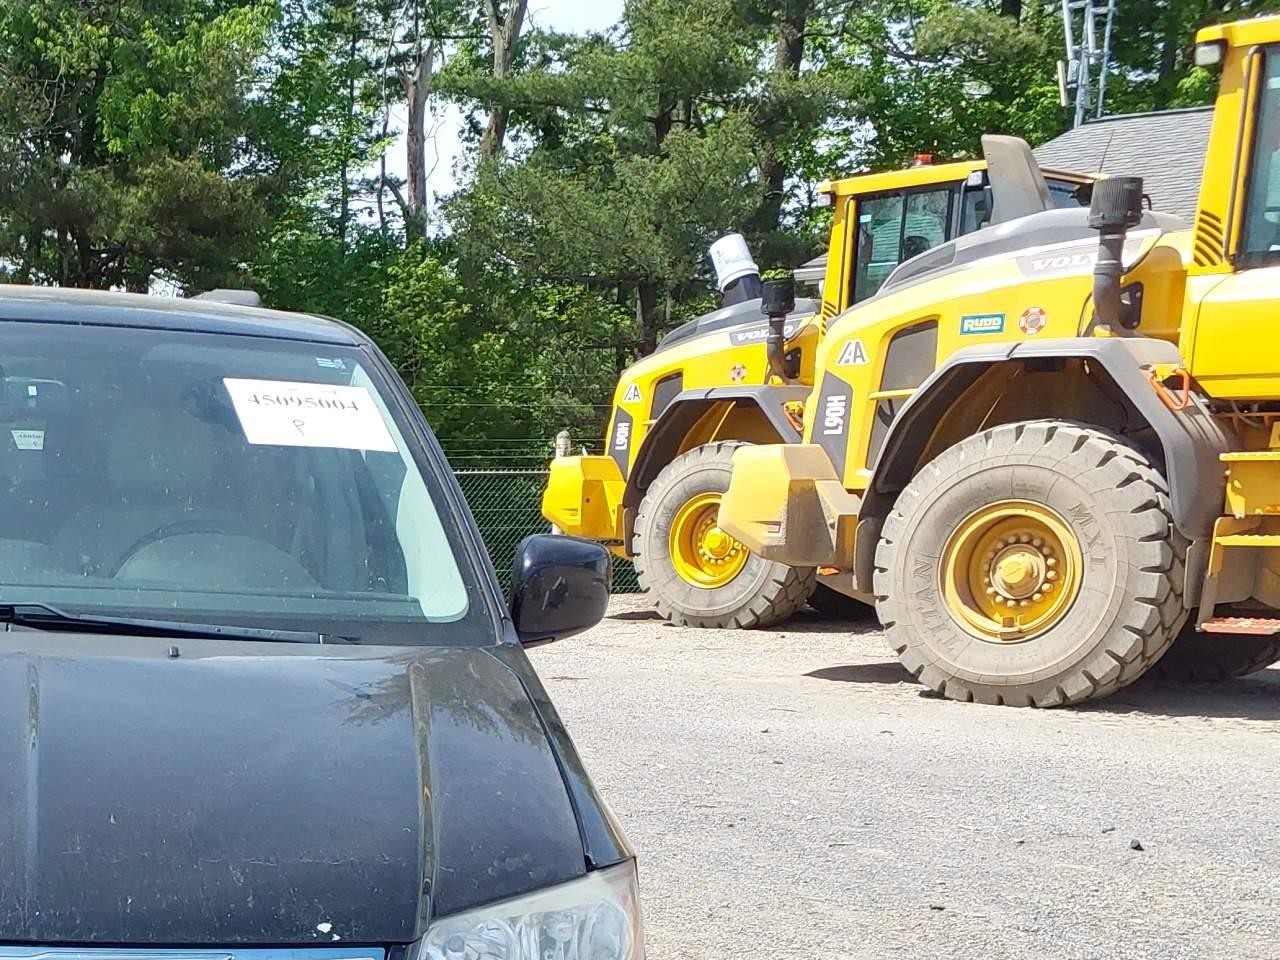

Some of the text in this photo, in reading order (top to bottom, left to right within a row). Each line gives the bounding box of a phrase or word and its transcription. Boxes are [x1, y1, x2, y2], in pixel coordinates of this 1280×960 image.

[736, 323, 794, 341] VOLO
[823, 395, 847, 435] L90H
[614, 422, 630, 451] L90H
